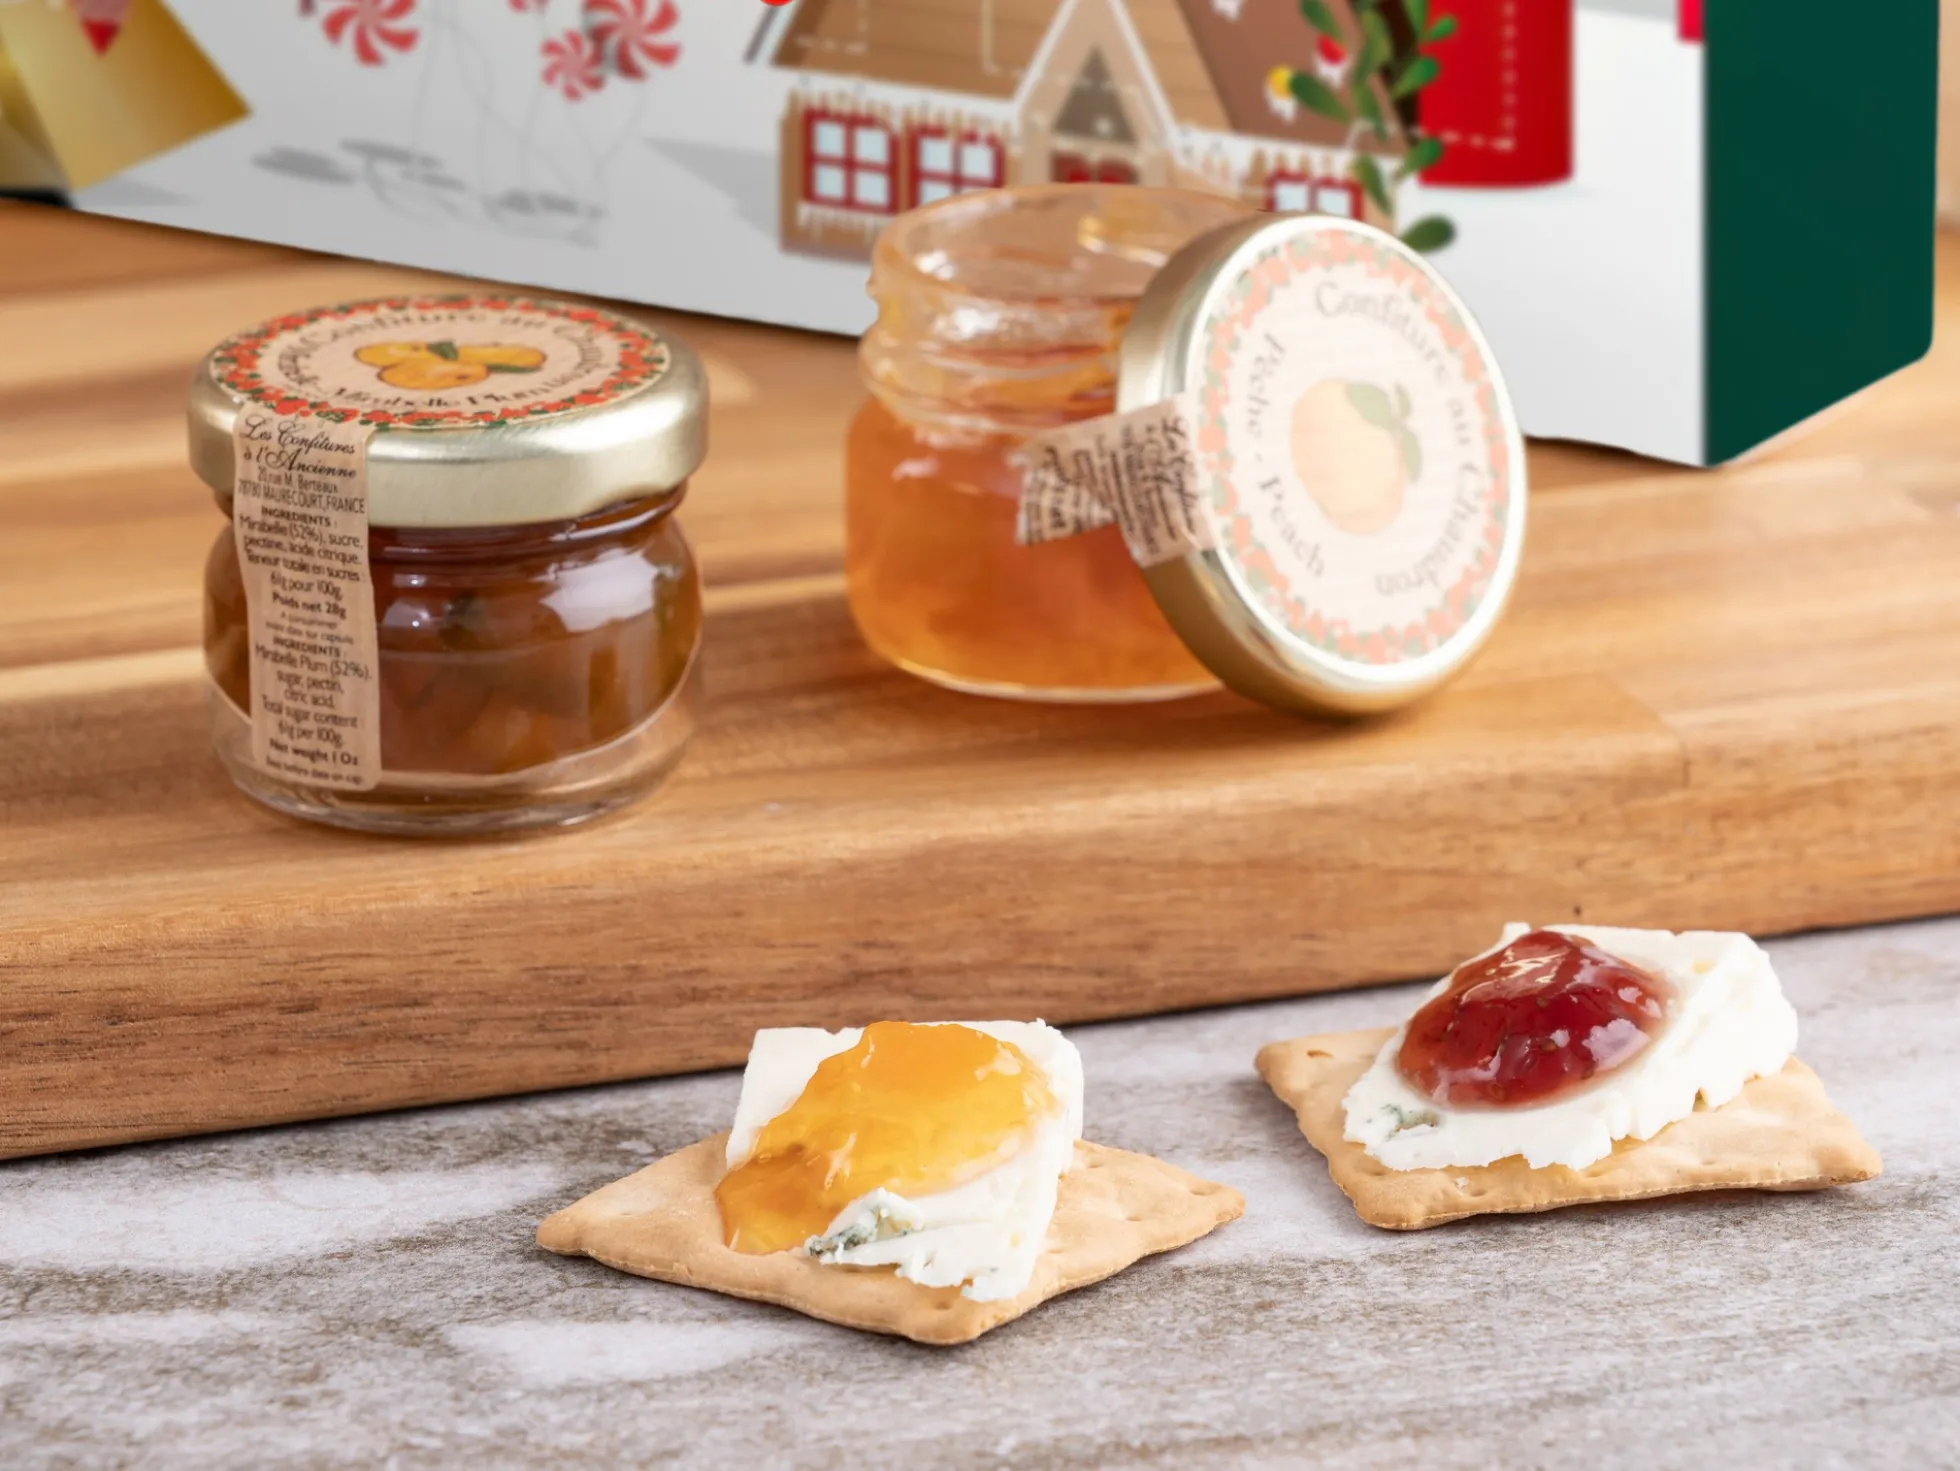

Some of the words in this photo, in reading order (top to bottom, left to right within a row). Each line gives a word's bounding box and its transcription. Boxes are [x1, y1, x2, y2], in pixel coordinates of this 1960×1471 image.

[1314, 280, 1448, 381] Confiture
[1248, 332, 1286, 440] Pêche
[245, 414, 273, 441] Les
[278, 420, 355, 454] Confitures
[1446, 398, 1472, 446] au
[256, 446, 356, 478] l'Ancienne
[261, 506, 331, 528] INGREDIENTS
[1260, 475, 1325, 577] Peach
[1375, 461, 1482, 597] Chaudron
[302, 602, 321, 613] net
[273, 636, 340, 658] INGREDIENTS
[300, 655, 328, 673] Plum
[313, 712, 357, 728] content
